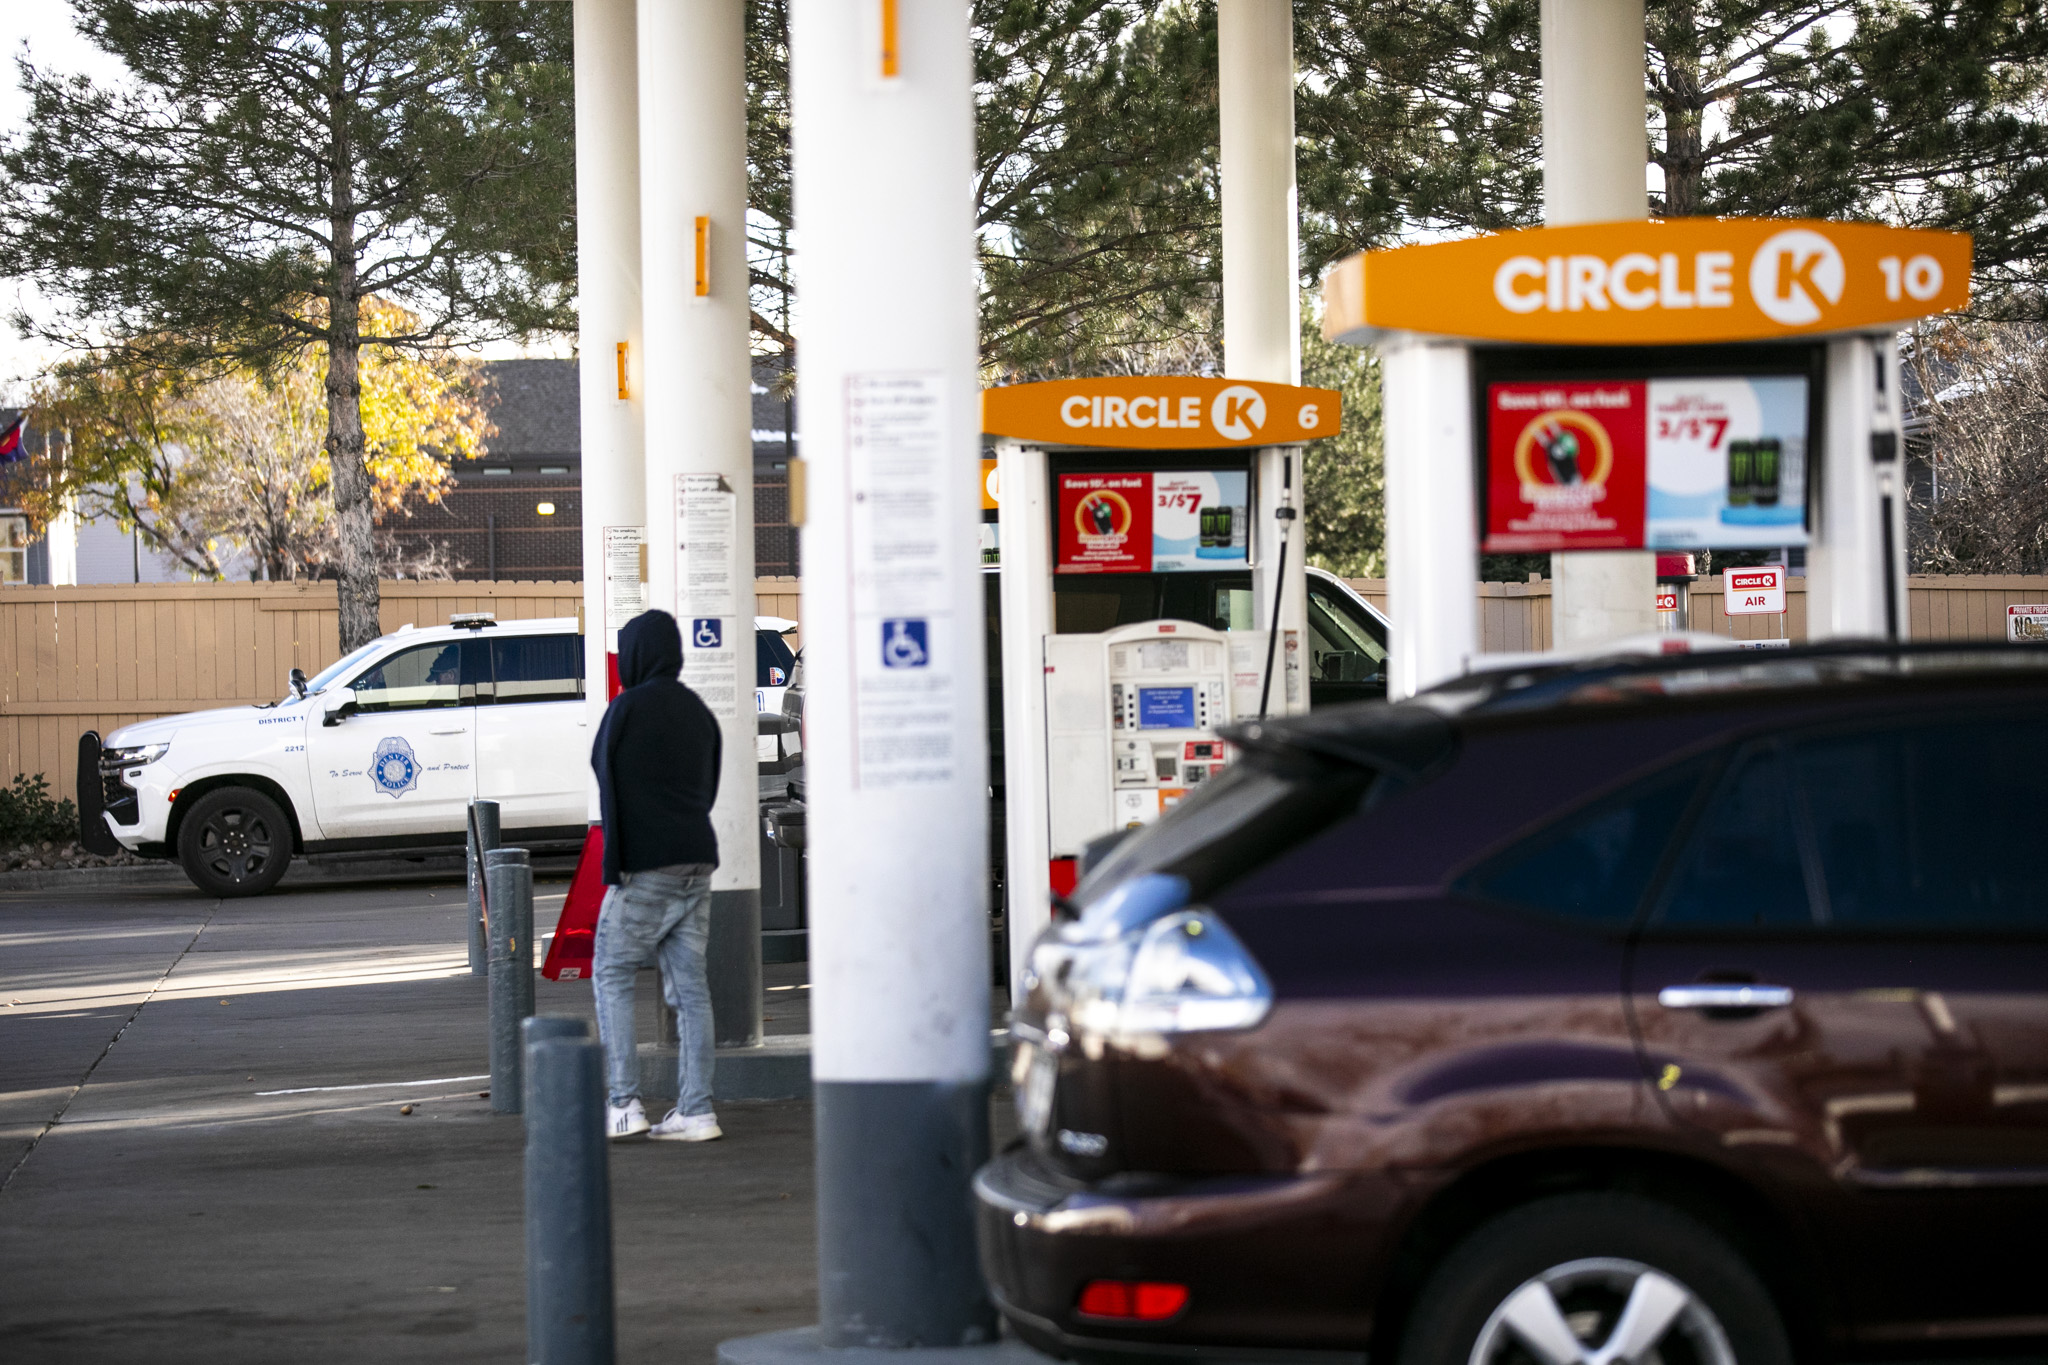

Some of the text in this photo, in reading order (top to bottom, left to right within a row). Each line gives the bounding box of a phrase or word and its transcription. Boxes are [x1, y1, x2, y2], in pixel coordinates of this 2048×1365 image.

[1879, 255, 1943, 301] 10
[1493, 246, 1843, 324] CIRCLE K
[1060, 393, 1265, 438] CIRCLE K
[1298, 404, 1319, 430] 6
[1657, 417, 1731, 450] 3/$7
[1064, 479, 1089, 489] Save
[1108, 480, 1121, 488] on
[1121, 478, 1142, 488] fuel
[1158, 493, 1202, 514] 3/$7
[1735, 576, 1773, 586] CIRCLE K
[1665, 597, 1674, 607] K
[1745, 596, 1766, 607] AIR
[2013, 606, 2032, 614] PRIVATE
[2014, 616, 2032, 635] NO
[258, 715, 297, 725] DISTRICT
[379, 752, 410, 767] DENVER
[329, 769, 363, 778] To Serve
[443, 763, 470, 771] Protect
[381, 776, 410, 789] POLICE
